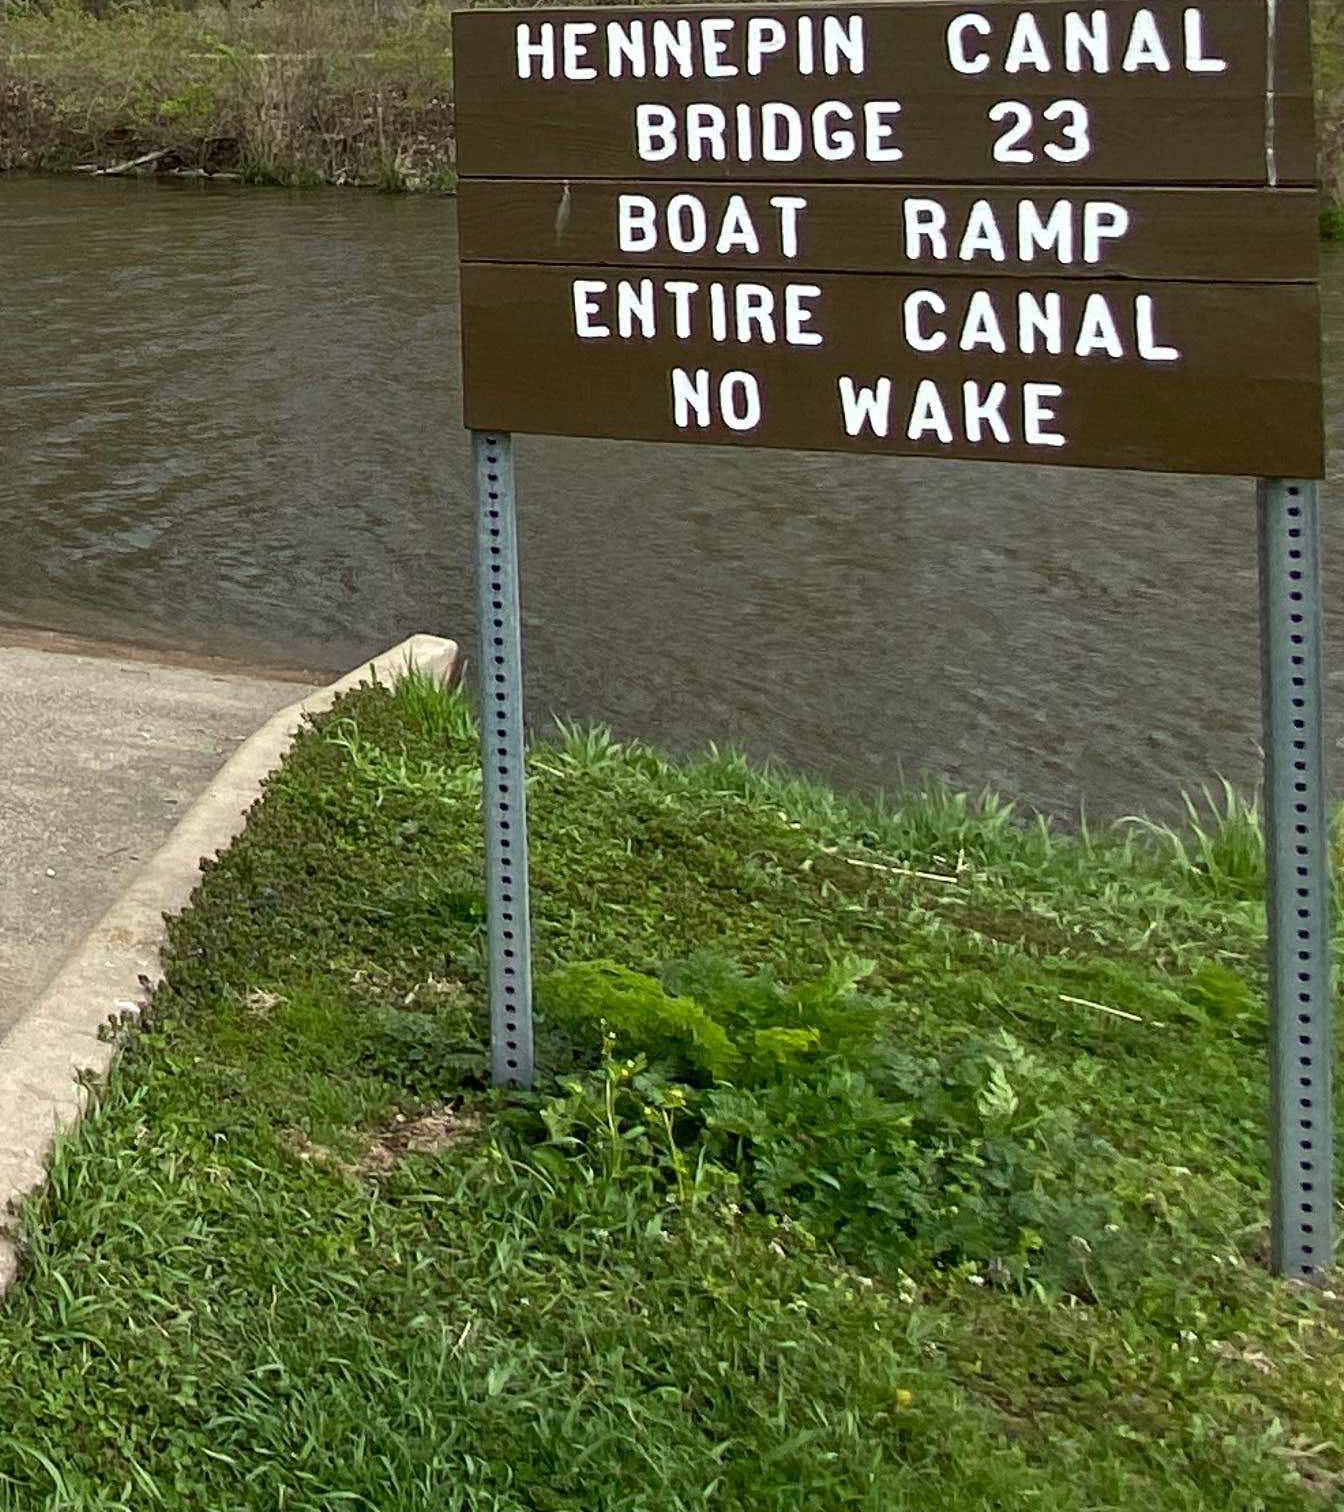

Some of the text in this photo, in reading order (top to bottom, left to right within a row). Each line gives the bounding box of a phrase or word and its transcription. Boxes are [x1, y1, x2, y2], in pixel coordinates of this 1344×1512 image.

[517, 8, 1227, 80] HENNEPIN CANAL
[636, 99, 1090, 163] BRIDGE 23
[618, 194, 1129, 264] BOAT RAMP
[573, 278, 1179, 361] ENTIRE CANAL
[672, 368, 1066, 447] NO WAKE
